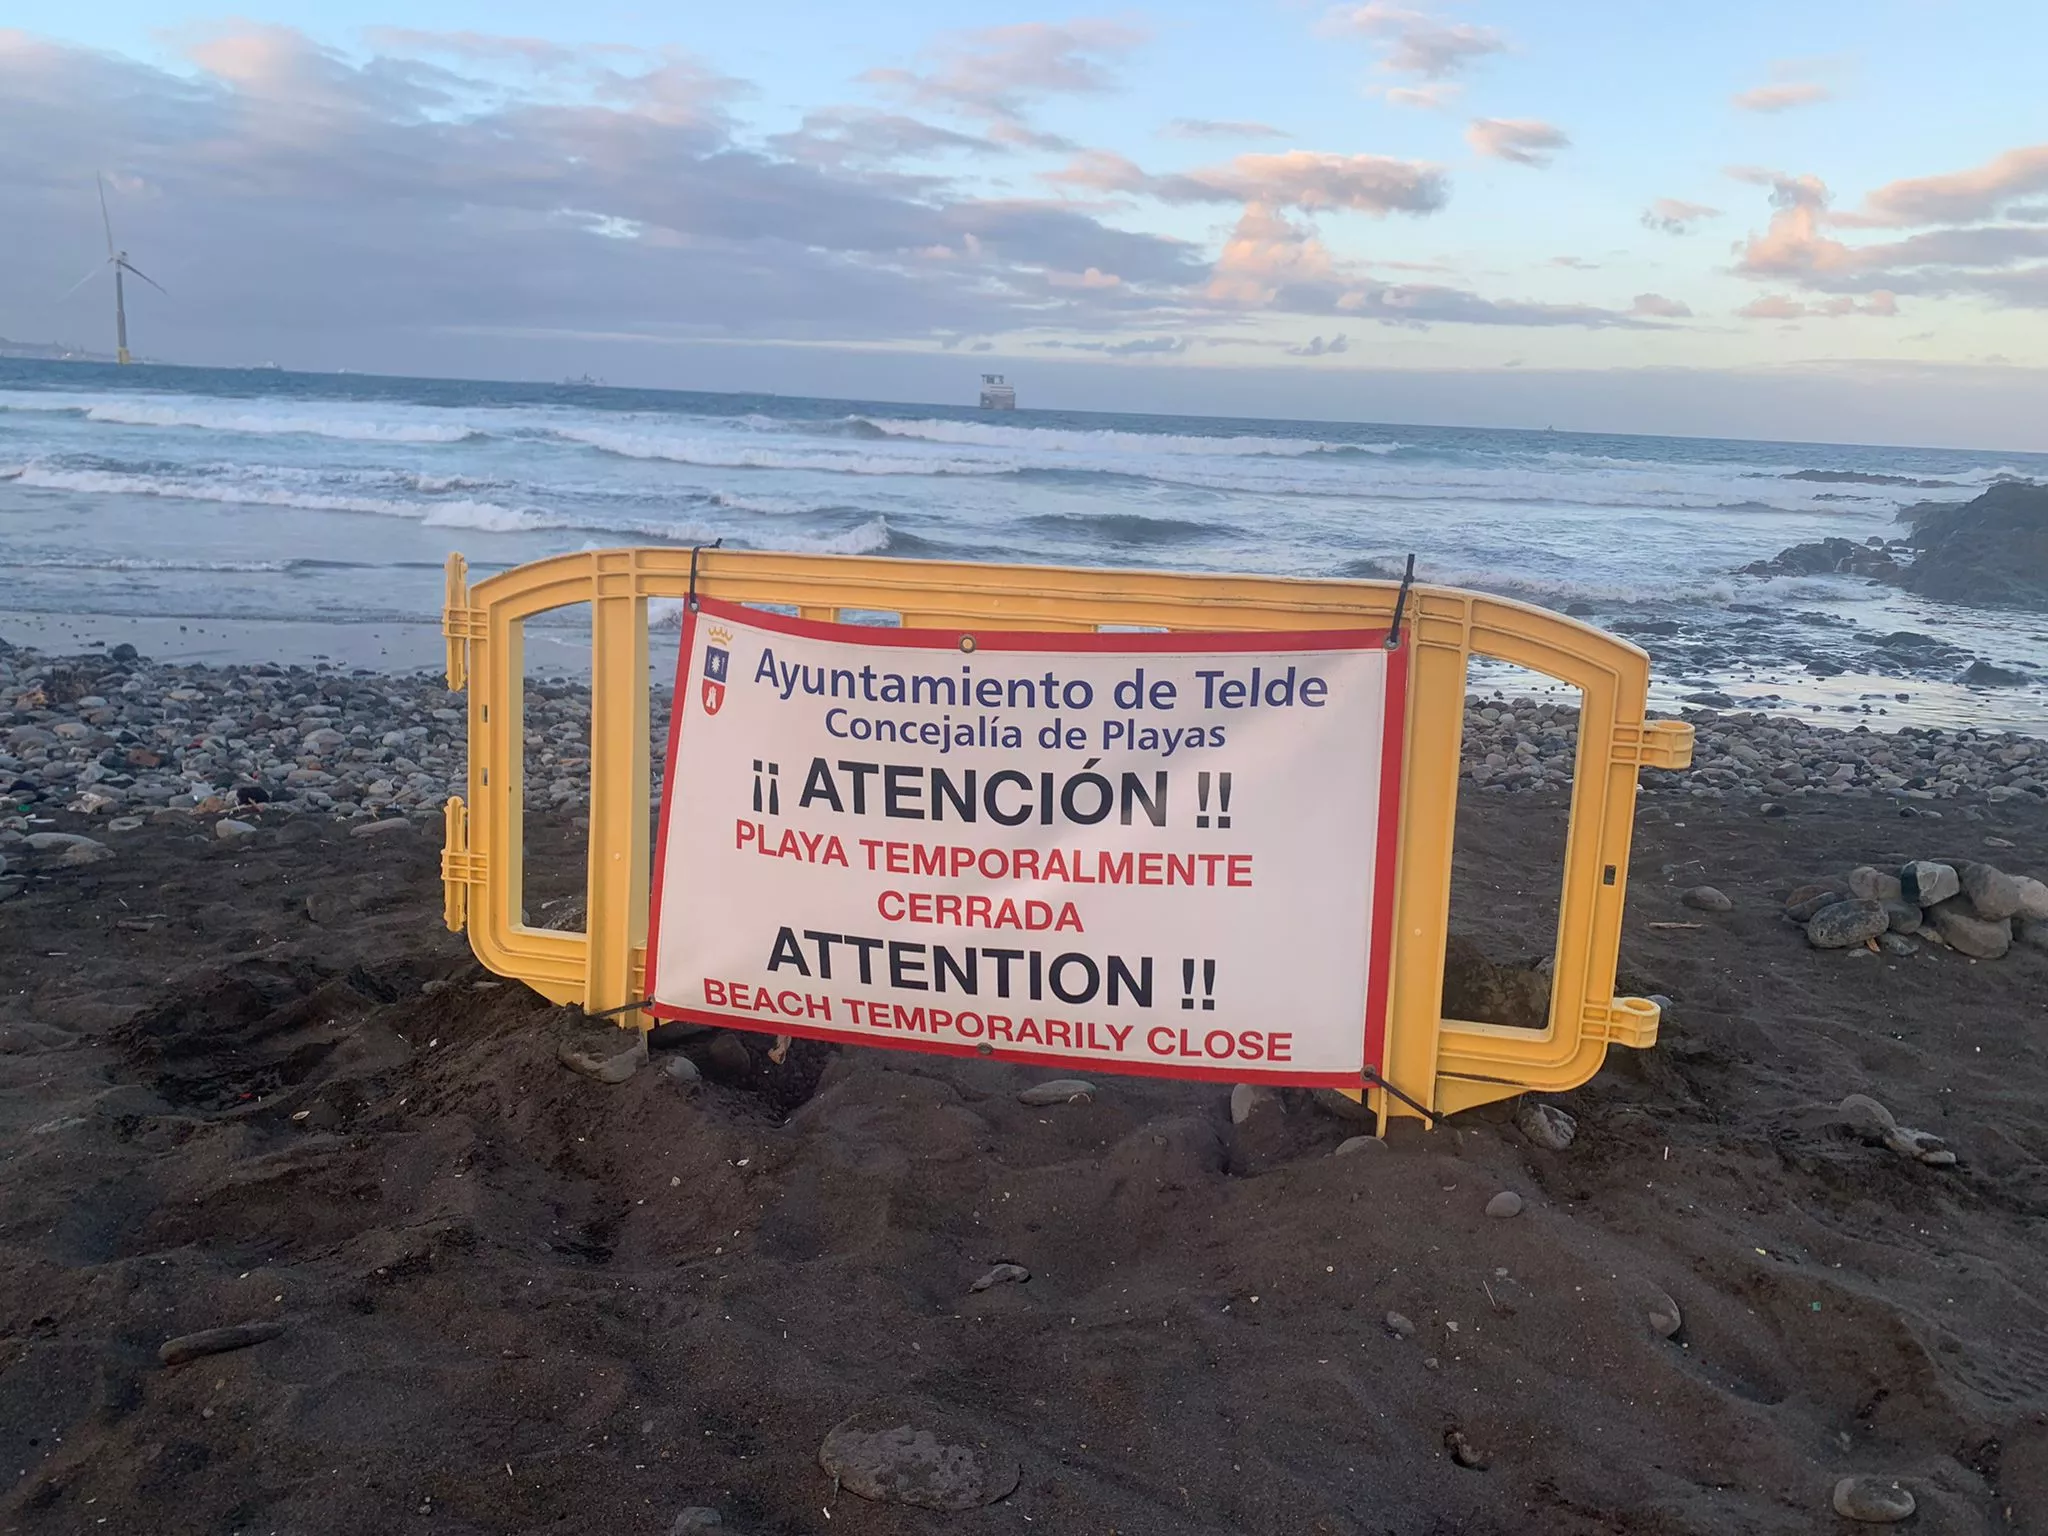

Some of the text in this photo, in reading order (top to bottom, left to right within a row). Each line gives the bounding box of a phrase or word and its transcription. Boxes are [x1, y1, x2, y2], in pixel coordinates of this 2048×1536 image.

[755, 647, 1328, 710] Ayuntamiento de Telde
[825, 707, 1226, 757] Concejalía de Playas
[752, 757, 1232, 829] ¡¡ ATENCIÓN !!
[736, 819, 1253, 888] PLAYA TEMPORALMENTE
[877, 890, 1085, 933] CERRADA
[766, 926, 1216, 1011] ATTENTION !!
[703, 977, 1293, 1062] BEACH TEMPORARILY CLOSE
